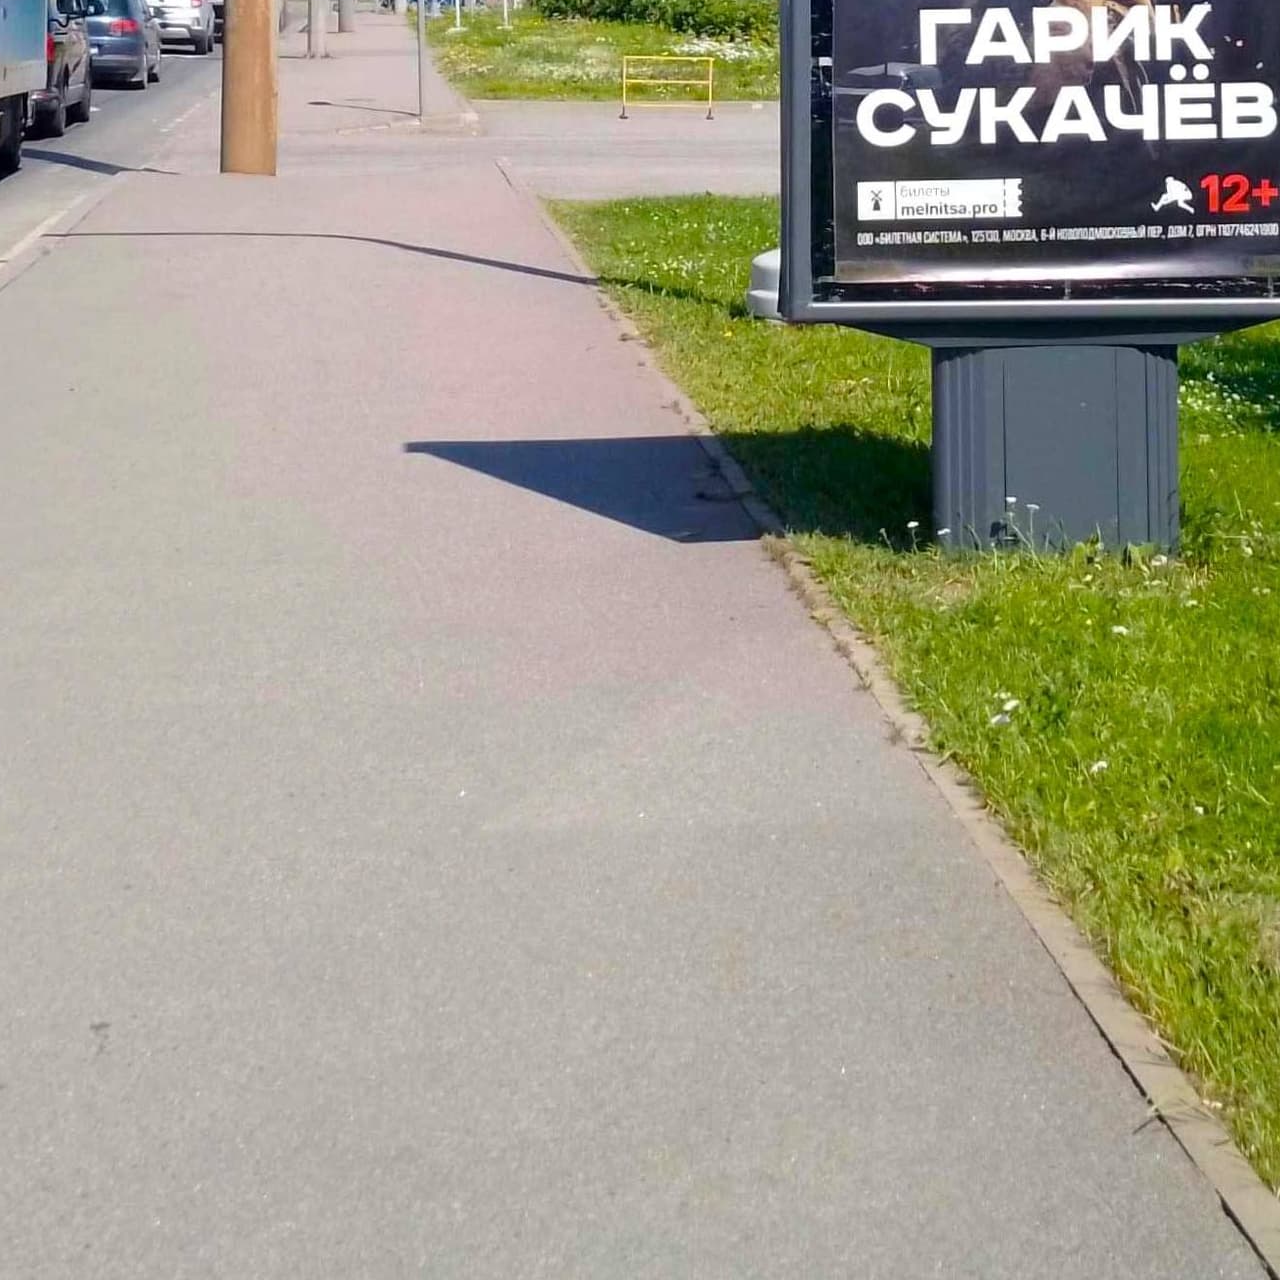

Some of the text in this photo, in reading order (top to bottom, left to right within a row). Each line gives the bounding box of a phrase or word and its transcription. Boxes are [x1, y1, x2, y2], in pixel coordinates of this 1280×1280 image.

[919, 3, 1215, 65] ГАРИК
[856, 63, 1278, 147] СУКАЧЁВ
[900, 185, 950, 199] билеты
[1200, 174, 1279, 213] 12+
[901, 202, 998, 219] melnitsa.pro
[857, 232, 873, 246] ООО
[1196, 224, 1216, 237] ОГРН
